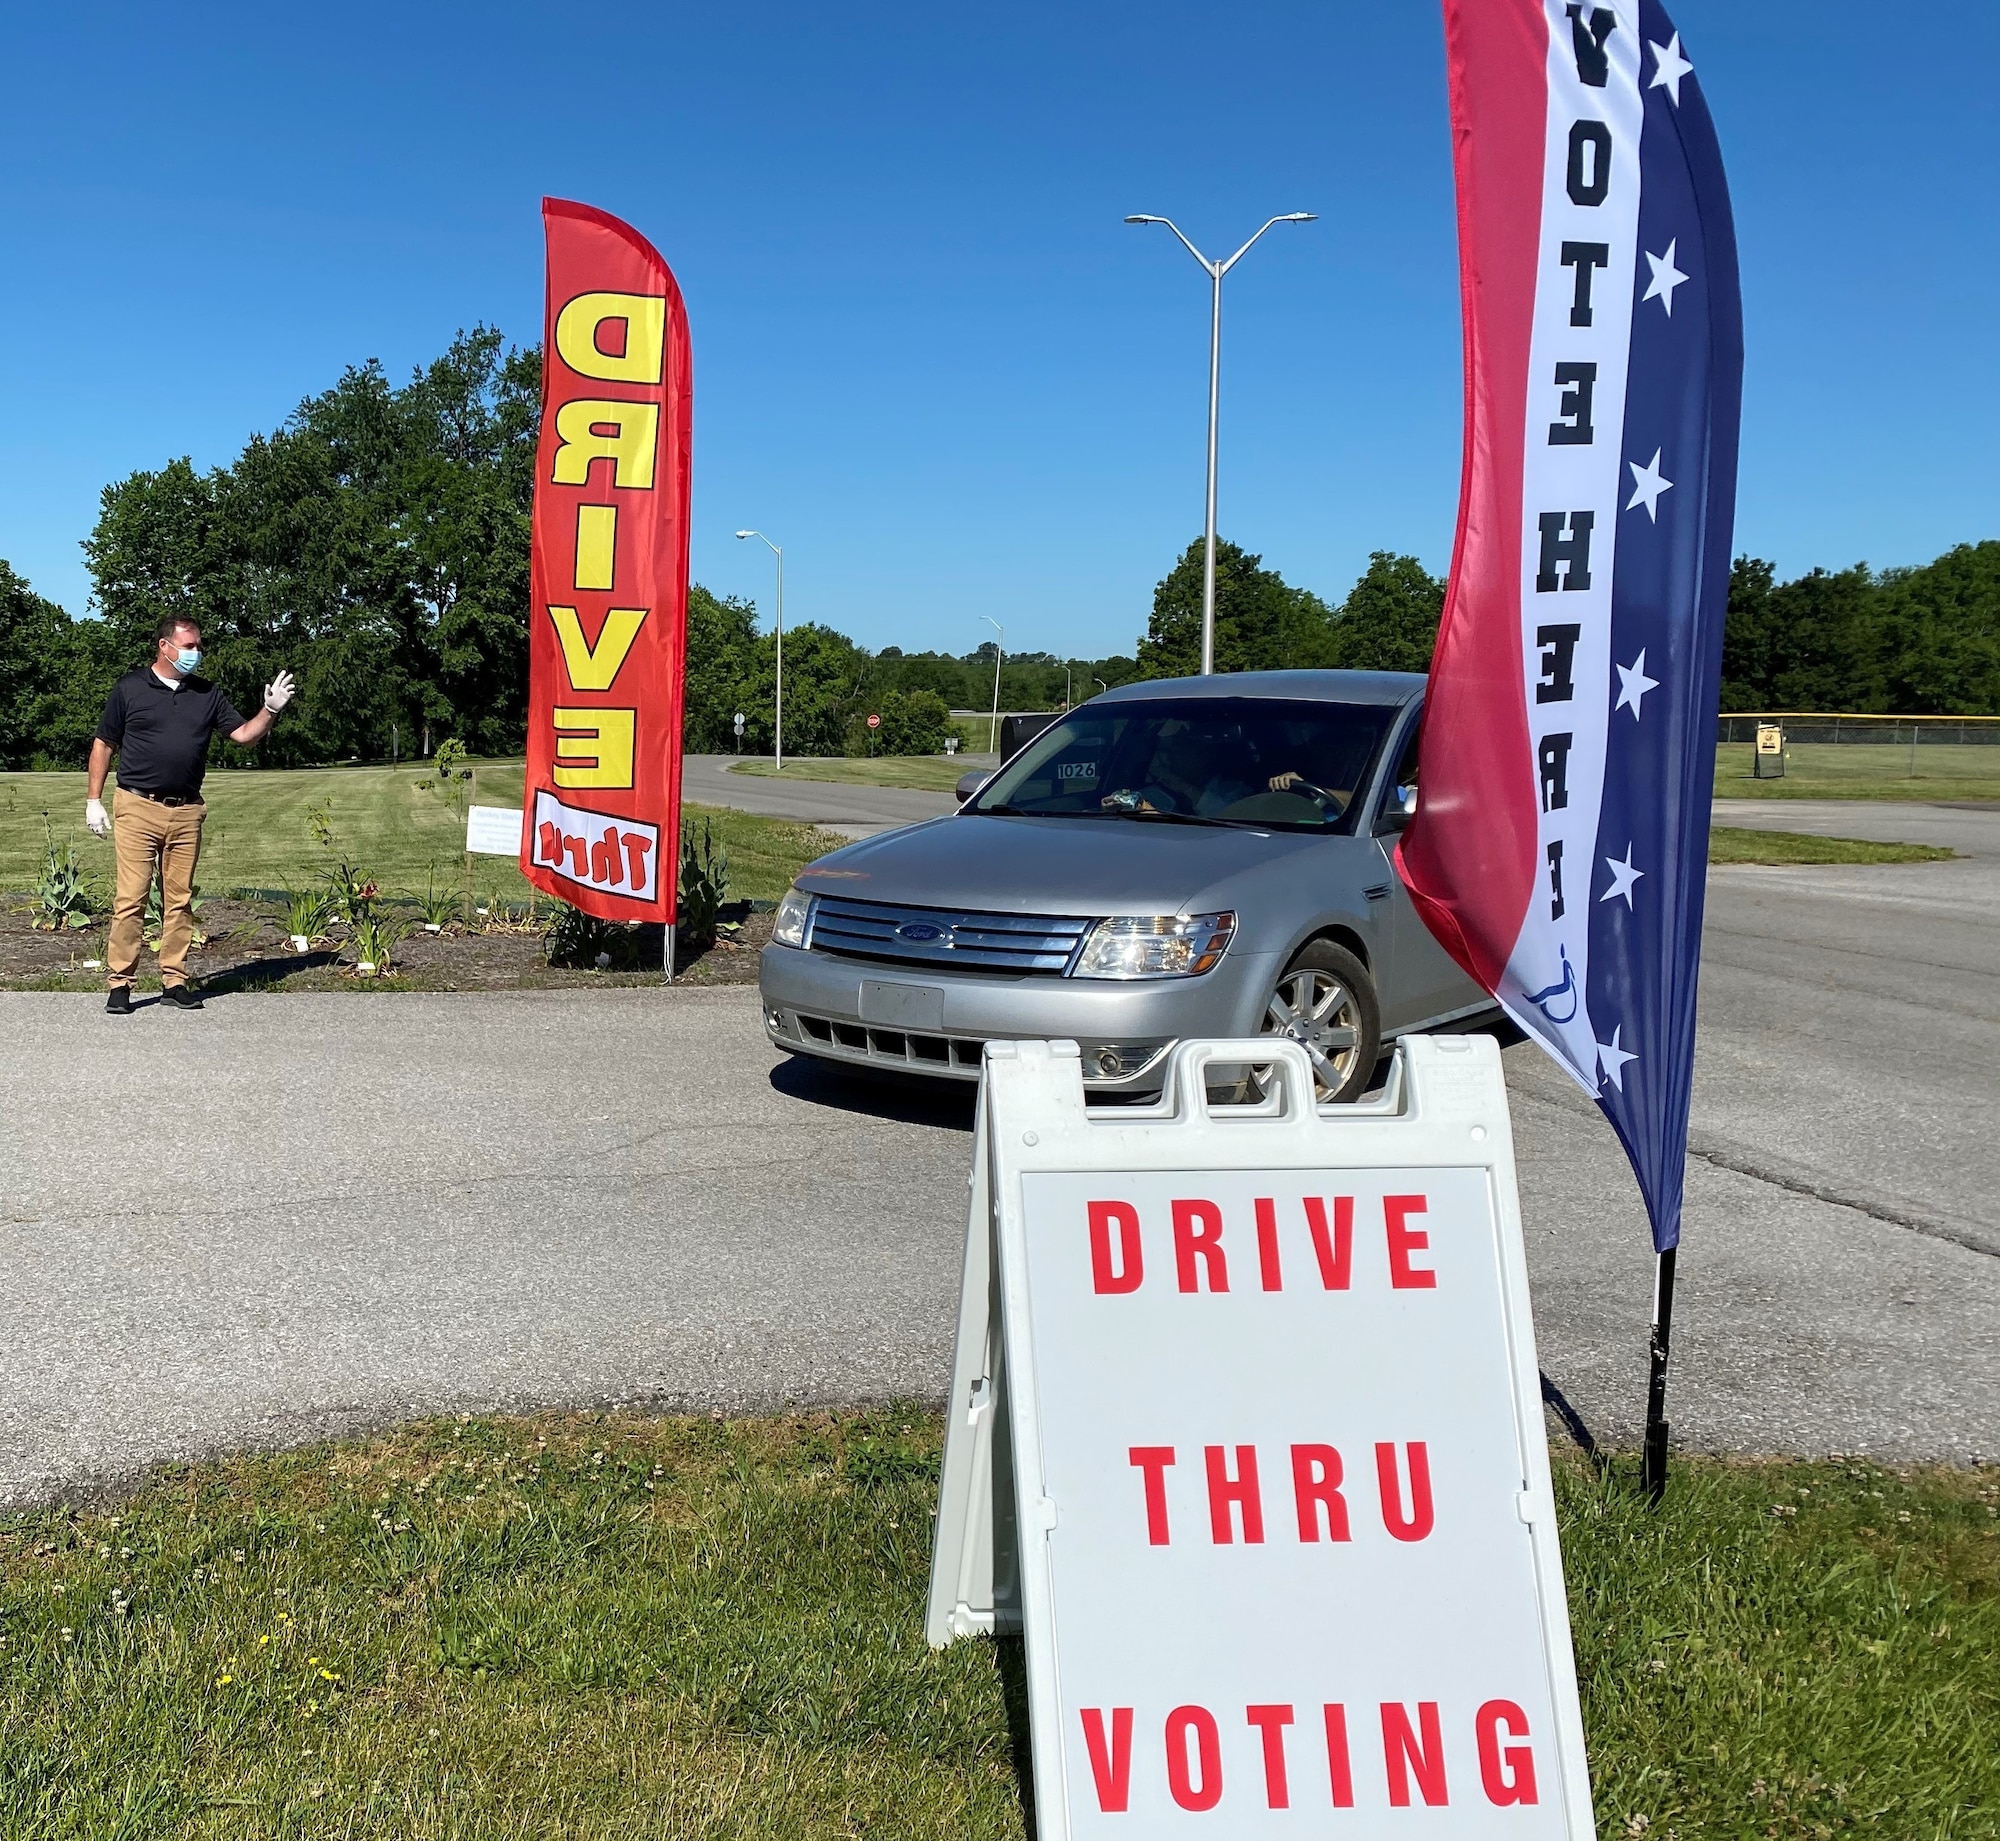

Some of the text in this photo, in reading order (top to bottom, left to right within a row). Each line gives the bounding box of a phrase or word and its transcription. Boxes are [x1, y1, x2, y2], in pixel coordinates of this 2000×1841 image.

[1059, 763, 1094, 778] 1026
[907, 927, 933, 938] Ford
[1087, 1194, 1437, 1295] DRIVE
[1128, 1441, 1435, 1546] THRU
[1080, 1698, 1539, 1812] VOTING
